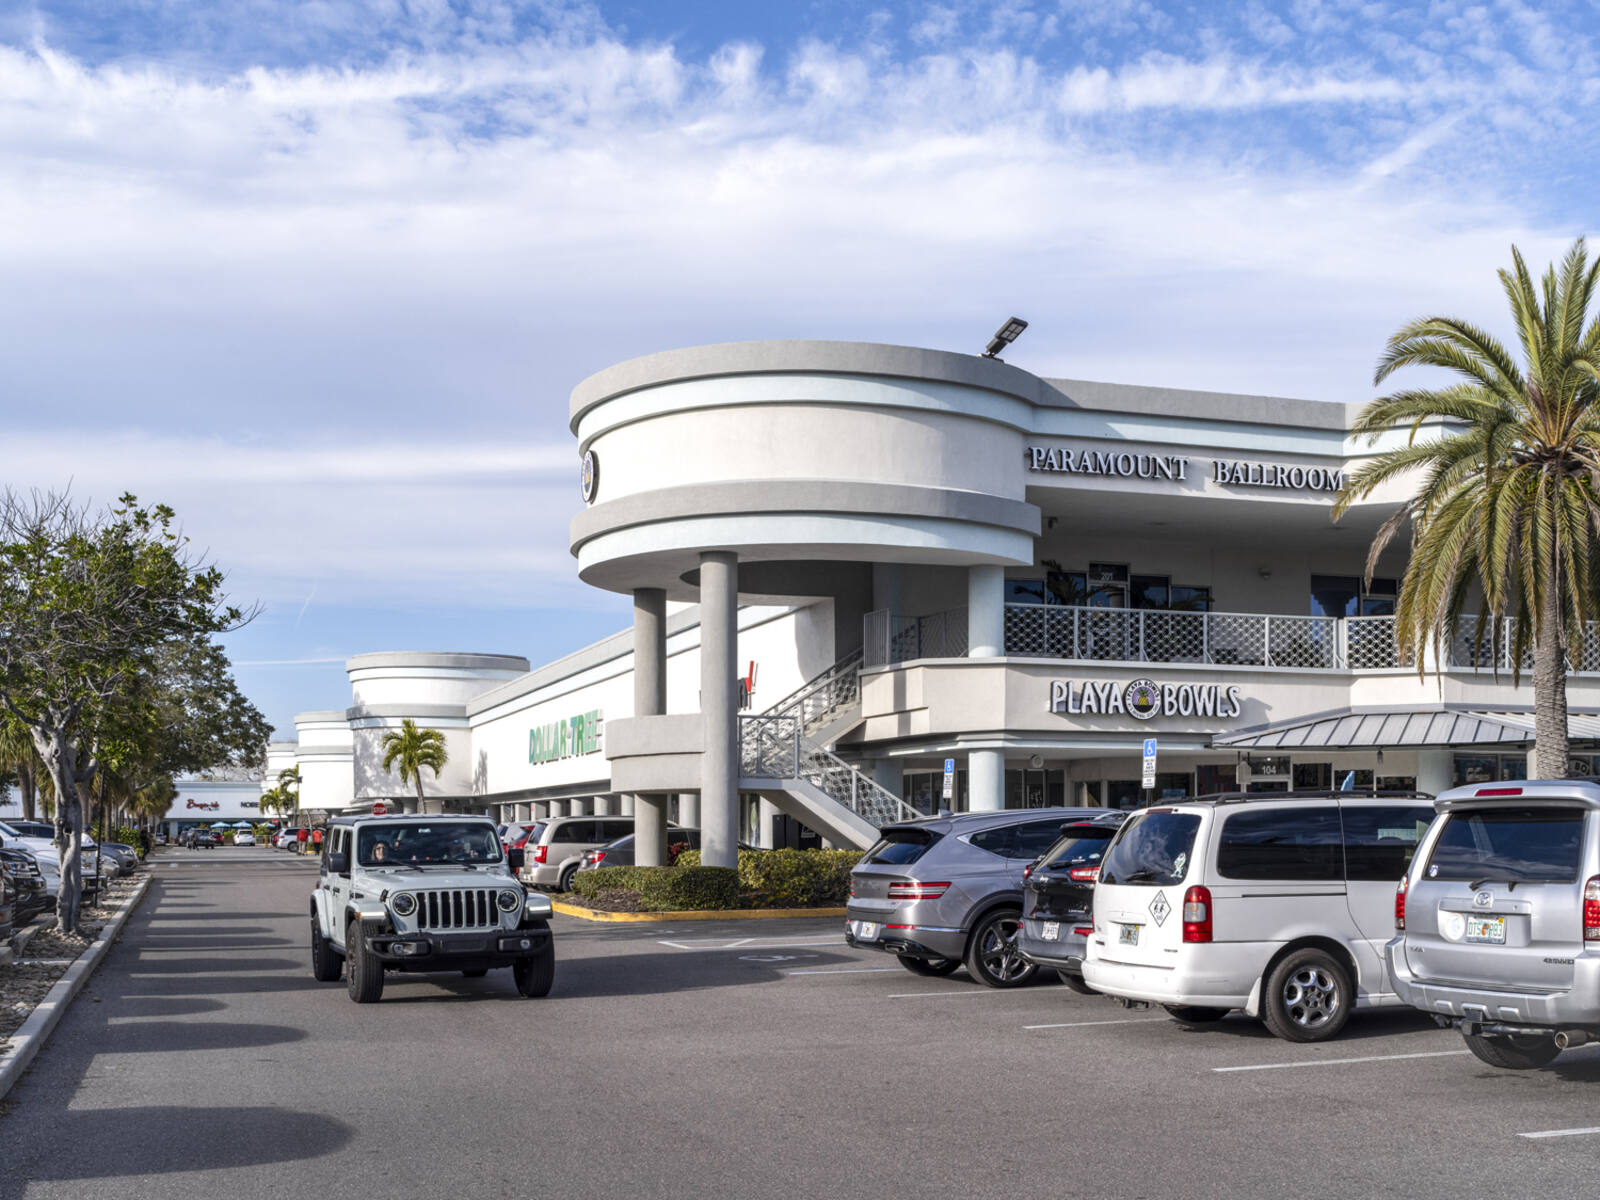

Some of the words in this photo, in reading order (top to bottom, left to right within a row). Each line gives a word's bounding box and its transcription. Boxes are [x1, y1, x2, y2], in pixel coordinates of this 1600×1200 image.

[1029, 446, 1189, 480] PARAMOUNT
[1213, 461, 1344, 491] BALLROOM
[1050, 680, 1124, 715] PLAYA
[1161, 684, 1241, 718] BOWLS
[1127, 681, 1142, 697] PLAYA
[1144, 681, 1160, 698] BOWLS
[529, 720, 567, 764] DOLLAR
[570, 710, 601, 755] TREE
[1261, 765, 1277, 776] 104
